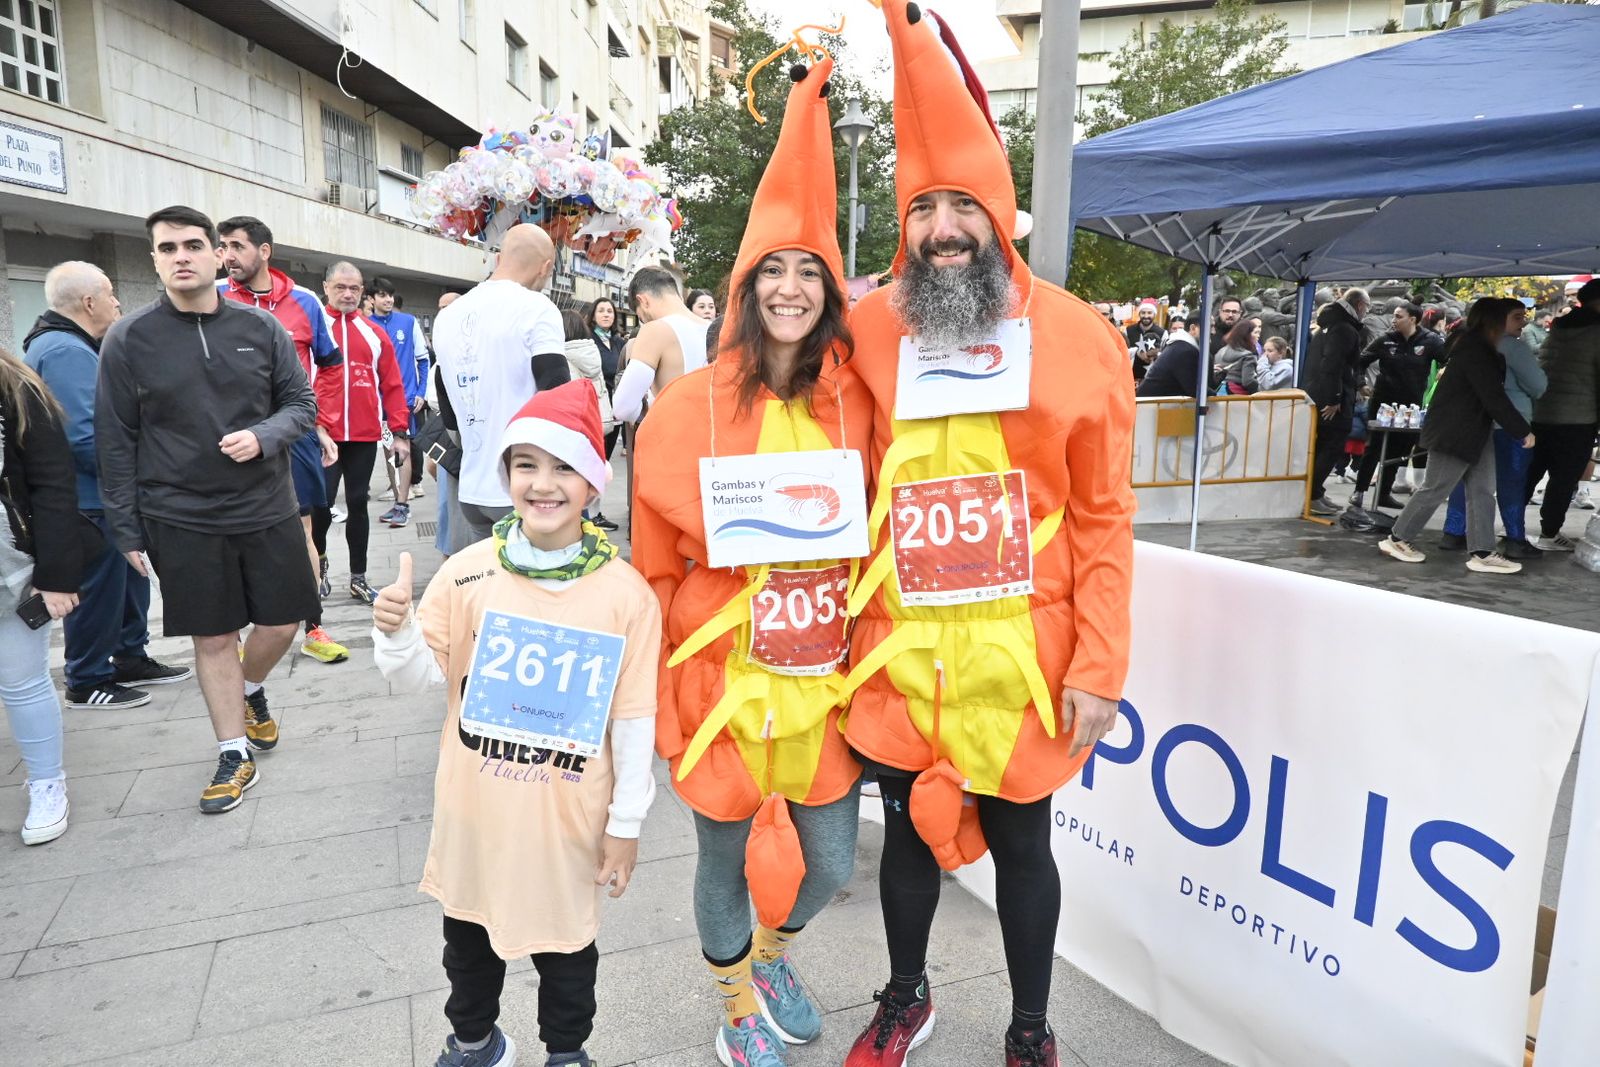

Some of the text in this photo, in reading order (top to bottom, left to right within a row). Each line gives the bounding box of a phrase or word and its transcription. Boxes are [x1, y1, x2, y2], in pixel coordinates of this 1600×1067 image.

[6, 134, 29, 153] PLAZA
[0, 154, 42, 175] DEL PUNTO
[711, 479, 766, 491] Gambas y
[712, 493, 763, 505] Mariscos
[898, 495, 1014, 549] 2051
[757, 577, 848, 631] 2053
[479, 635, 604, 697] 2611
[520, 705, 565, 719] ONUPOLIS
[480, 750, 551, 784] Huelva
[560, 771, 582, 783] 2025
[1055, 811, 1135, 866] OPULAR
[1180, 876, 1340, 976] DEPORTIVO
